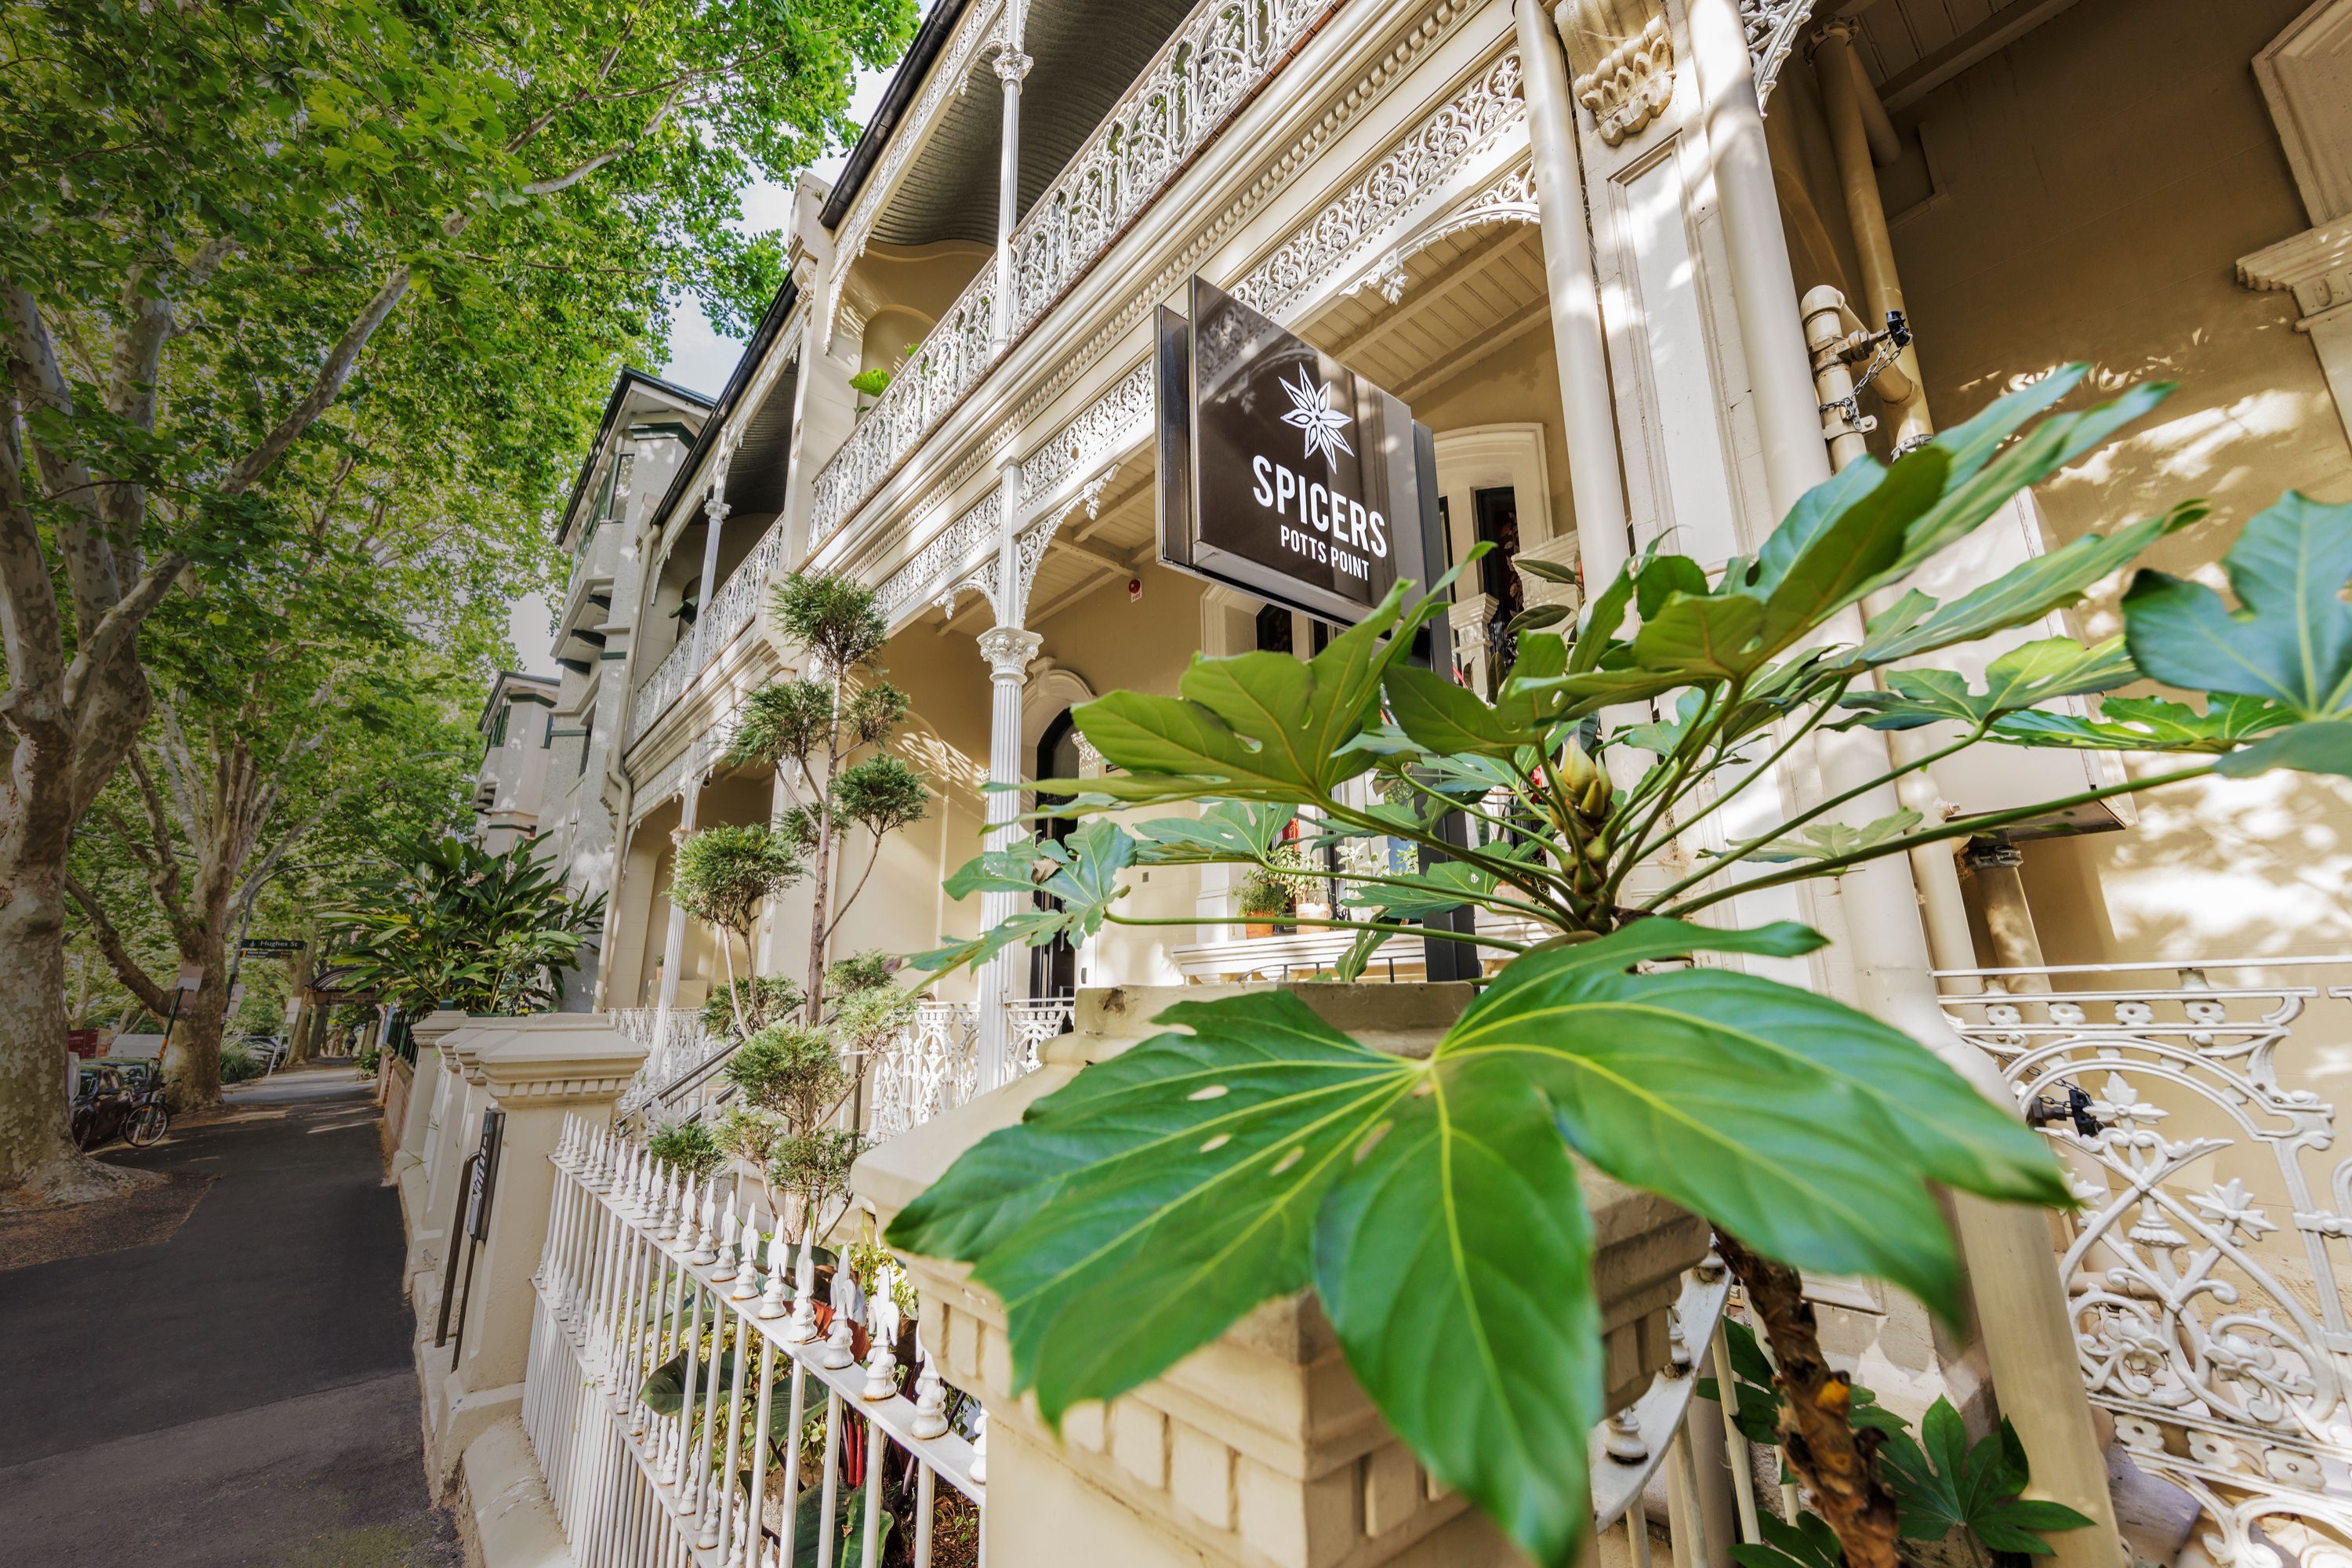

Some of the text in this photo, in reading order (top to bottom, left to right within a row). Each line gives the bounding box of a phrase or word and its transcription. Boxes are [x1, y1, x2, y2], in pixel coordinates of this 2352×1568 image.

[1253, 455, 1387, 557] SPICERS
[1280, 524, 1370, 581] POTTS POINT
